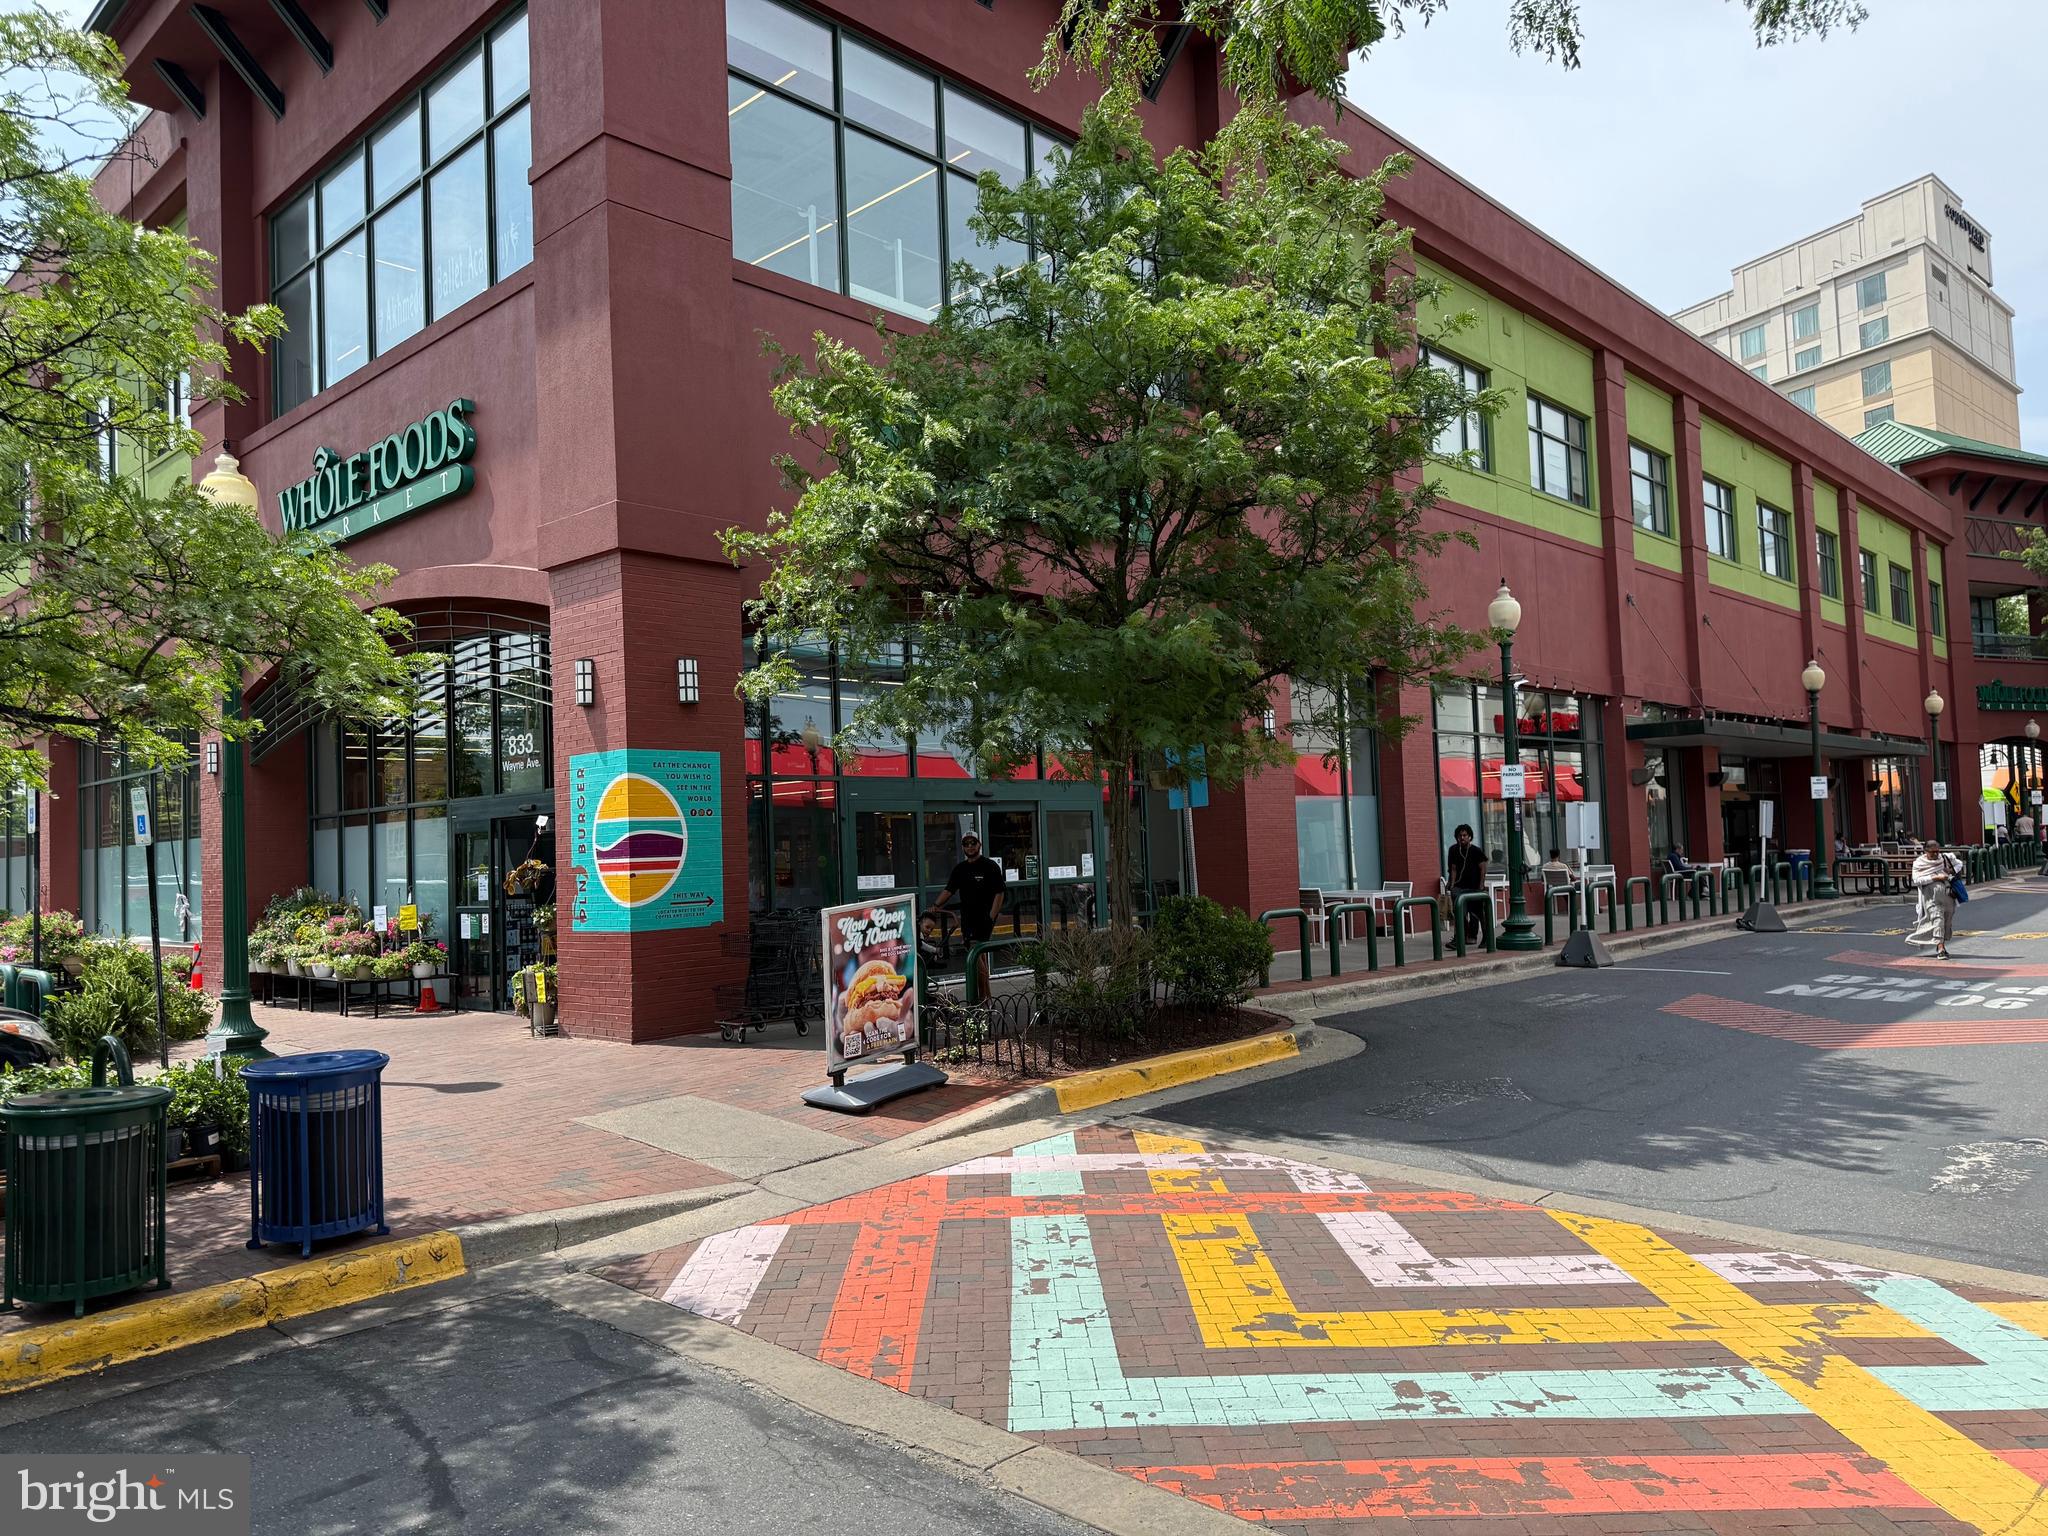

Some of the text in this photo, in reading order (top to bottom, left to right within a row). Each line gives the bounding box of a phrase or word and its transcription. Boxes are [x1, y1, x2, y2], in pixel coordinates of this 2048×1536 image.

[386, 282, 422, 334] Akhmedo
[437, 254, 464, 299] Ballet
[277, 398, 475, 535] WHOLE FOODS
[508, 733, 534, 756] 833
[502, 757, 541, 773] Wayne Ave.
[576, 767, 587, 854] BURGER
[837, 908, 906, 936] Now Open
[843, 921, 904, 954] At 10am!
[1764, 984, 2035, 1010] 90 MIN
